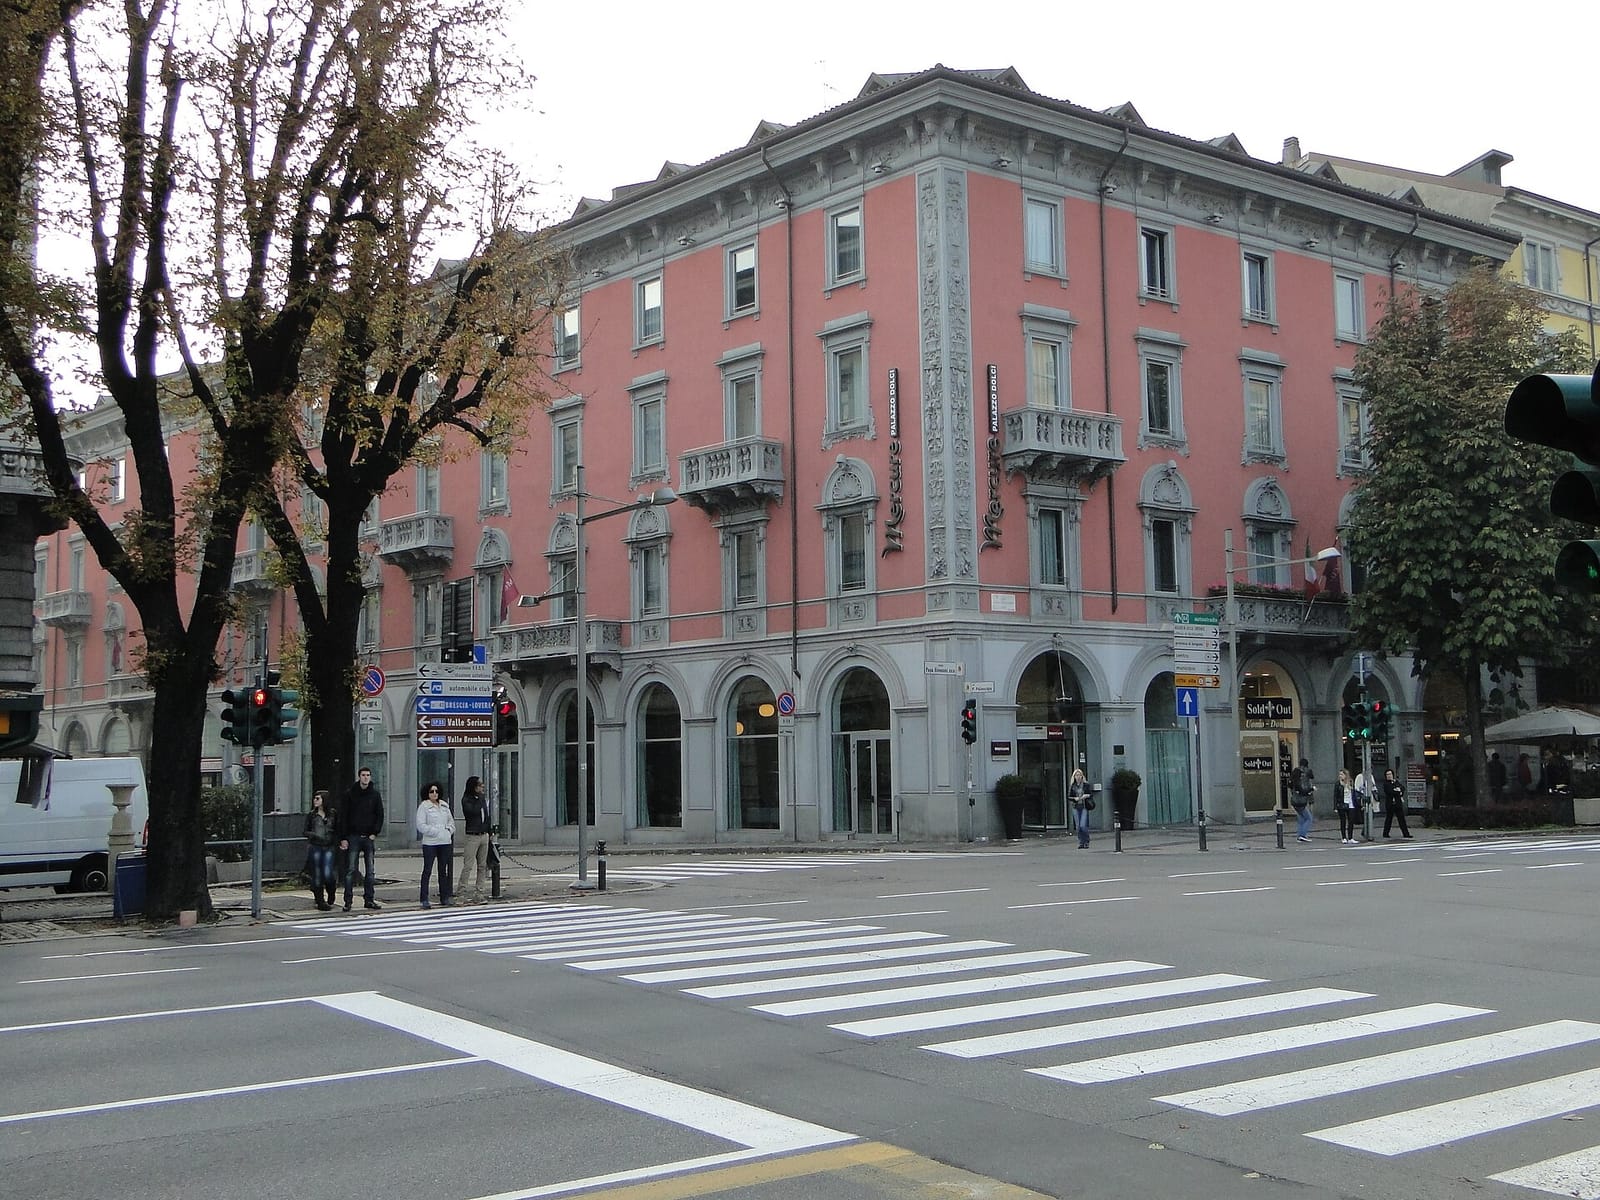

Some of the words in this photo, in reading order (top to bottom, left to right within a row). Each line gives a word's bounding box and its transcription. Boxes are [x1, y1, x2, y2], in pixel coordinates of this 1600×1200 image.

[882, 440, 905, 559] Mercure
[979, 437, 1004, 553] Mercure
[1247, 703, 1265, 714] Sold
[1276, 703, 1292, 715] Out
[447, 718, 465, 726] Valle
[466, 718, 491, 727] Seriana
[447, 735, 462, 743] Valle
